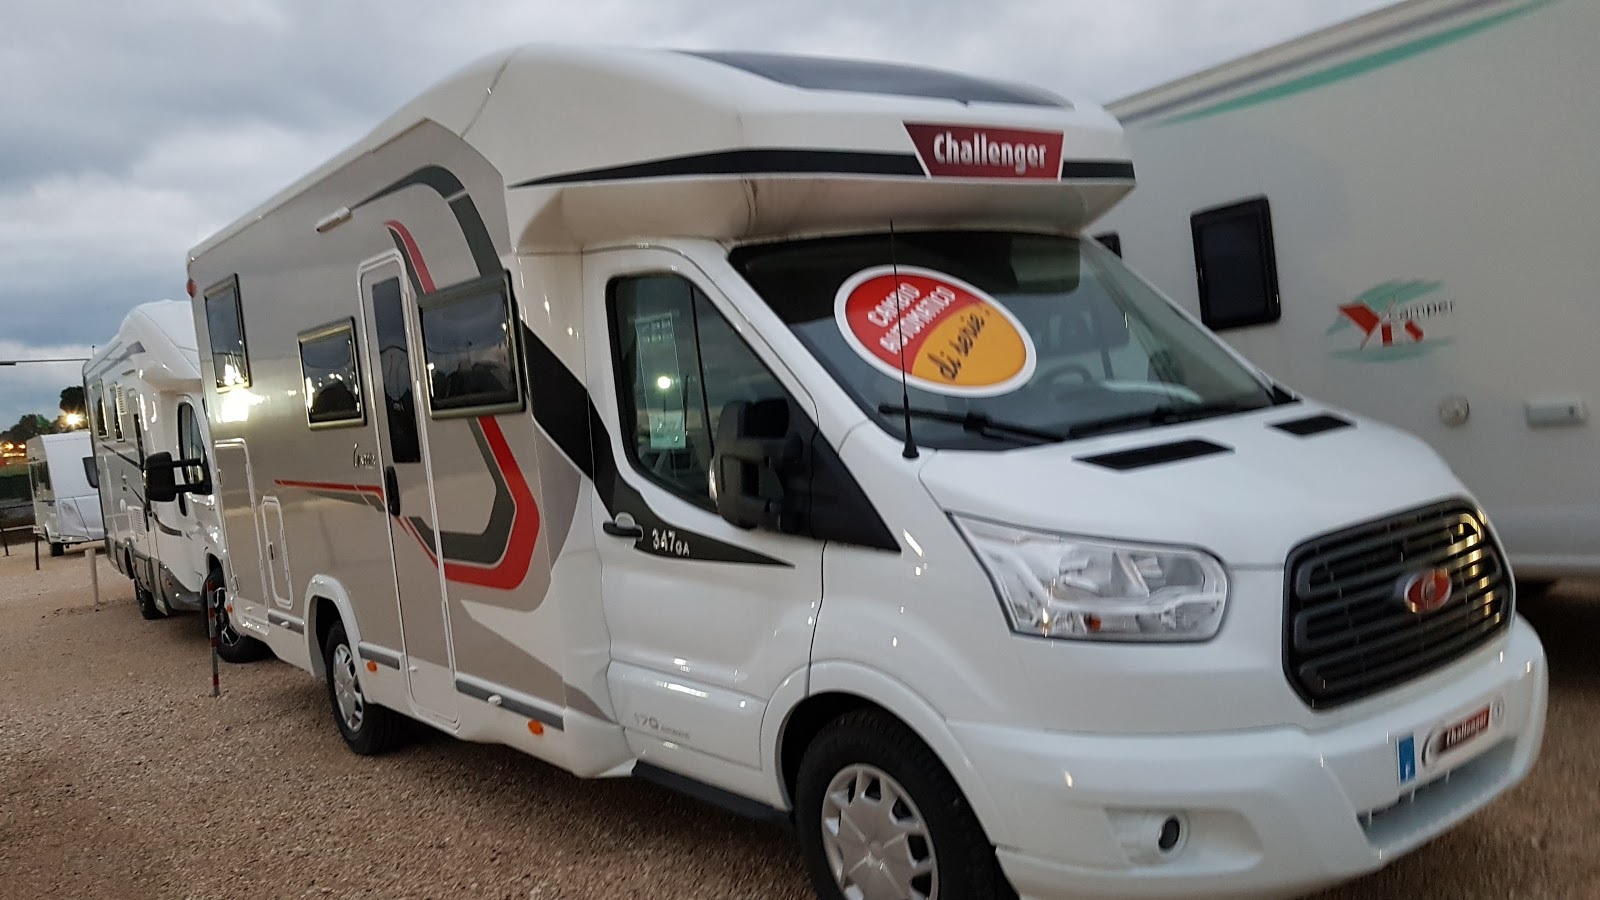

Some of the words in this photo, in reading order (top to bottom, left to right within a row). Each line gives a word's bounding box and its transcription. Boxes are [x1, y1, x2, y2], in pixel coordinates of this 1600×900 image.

[934, 130, 1047, 176] Challenger
[867, 282, 921, 328] CAMBIO
[879, 285, 956, 355] AUTOMATICO
[926, 351, 962, 382] di
